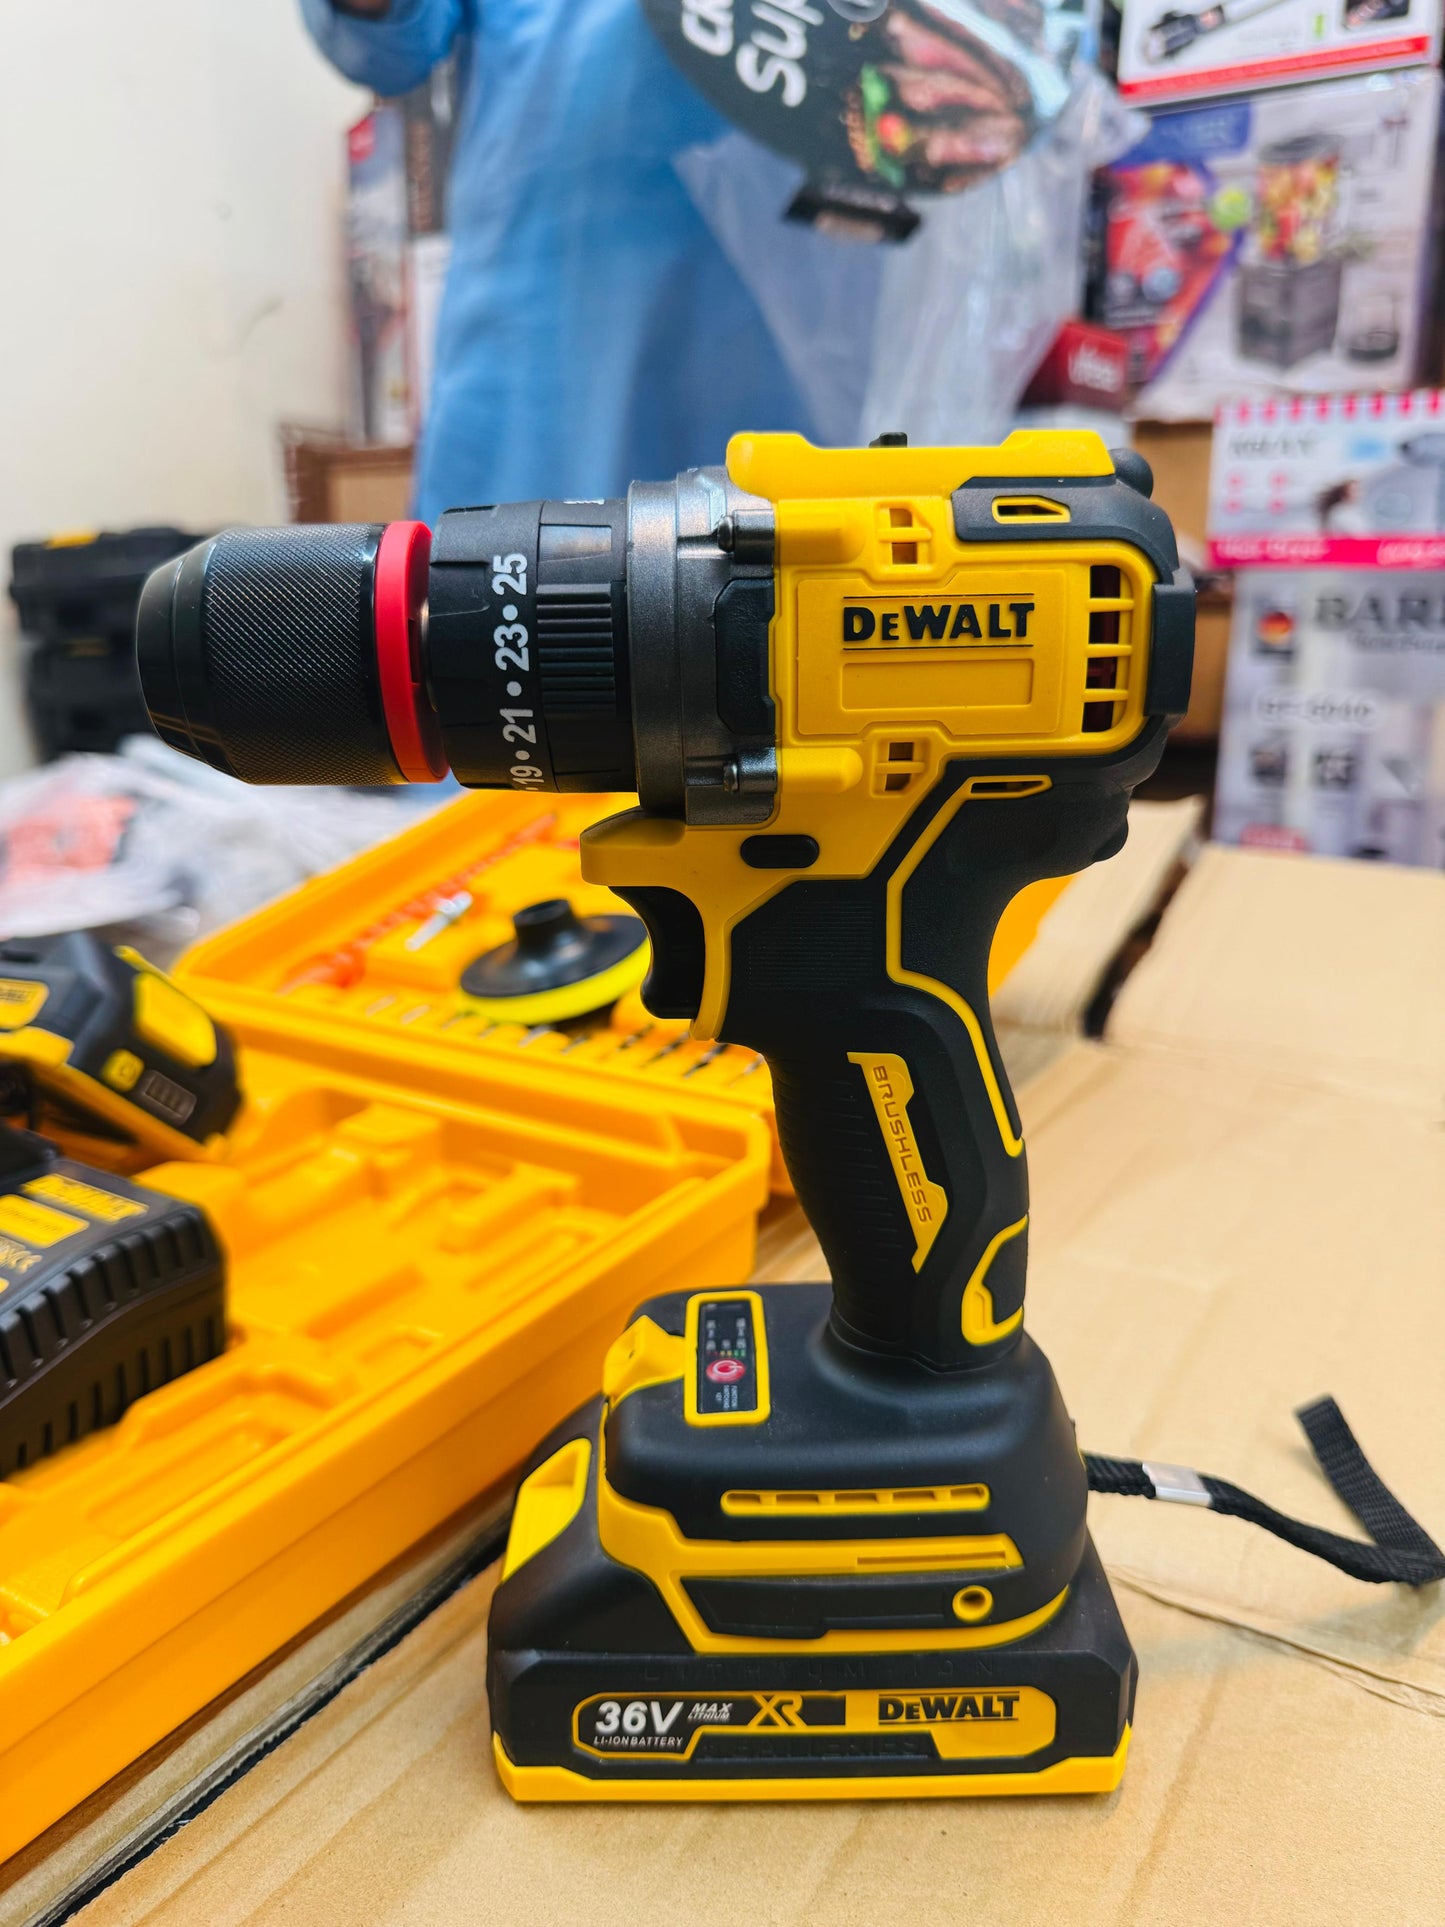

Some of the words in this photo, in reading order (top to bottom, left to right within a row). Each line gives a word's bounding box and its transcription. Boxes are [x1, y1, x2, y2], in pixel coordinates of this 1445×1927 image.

[491, 552, 528, 596] 25
[493, 623, 530, 672] 23
[499, 708, 537, 744] 21
[873, 1065, 932, 1223] BRUSHLESS
[595, 1701, 684, 1734] 36V
[687, 1712, 730, 1720] LITHIUM
[691, 1702, 733, 1713] MAX
[748, 1693, 808, 1728] XR
[630, 1736, 683, 1746] BATTERY
